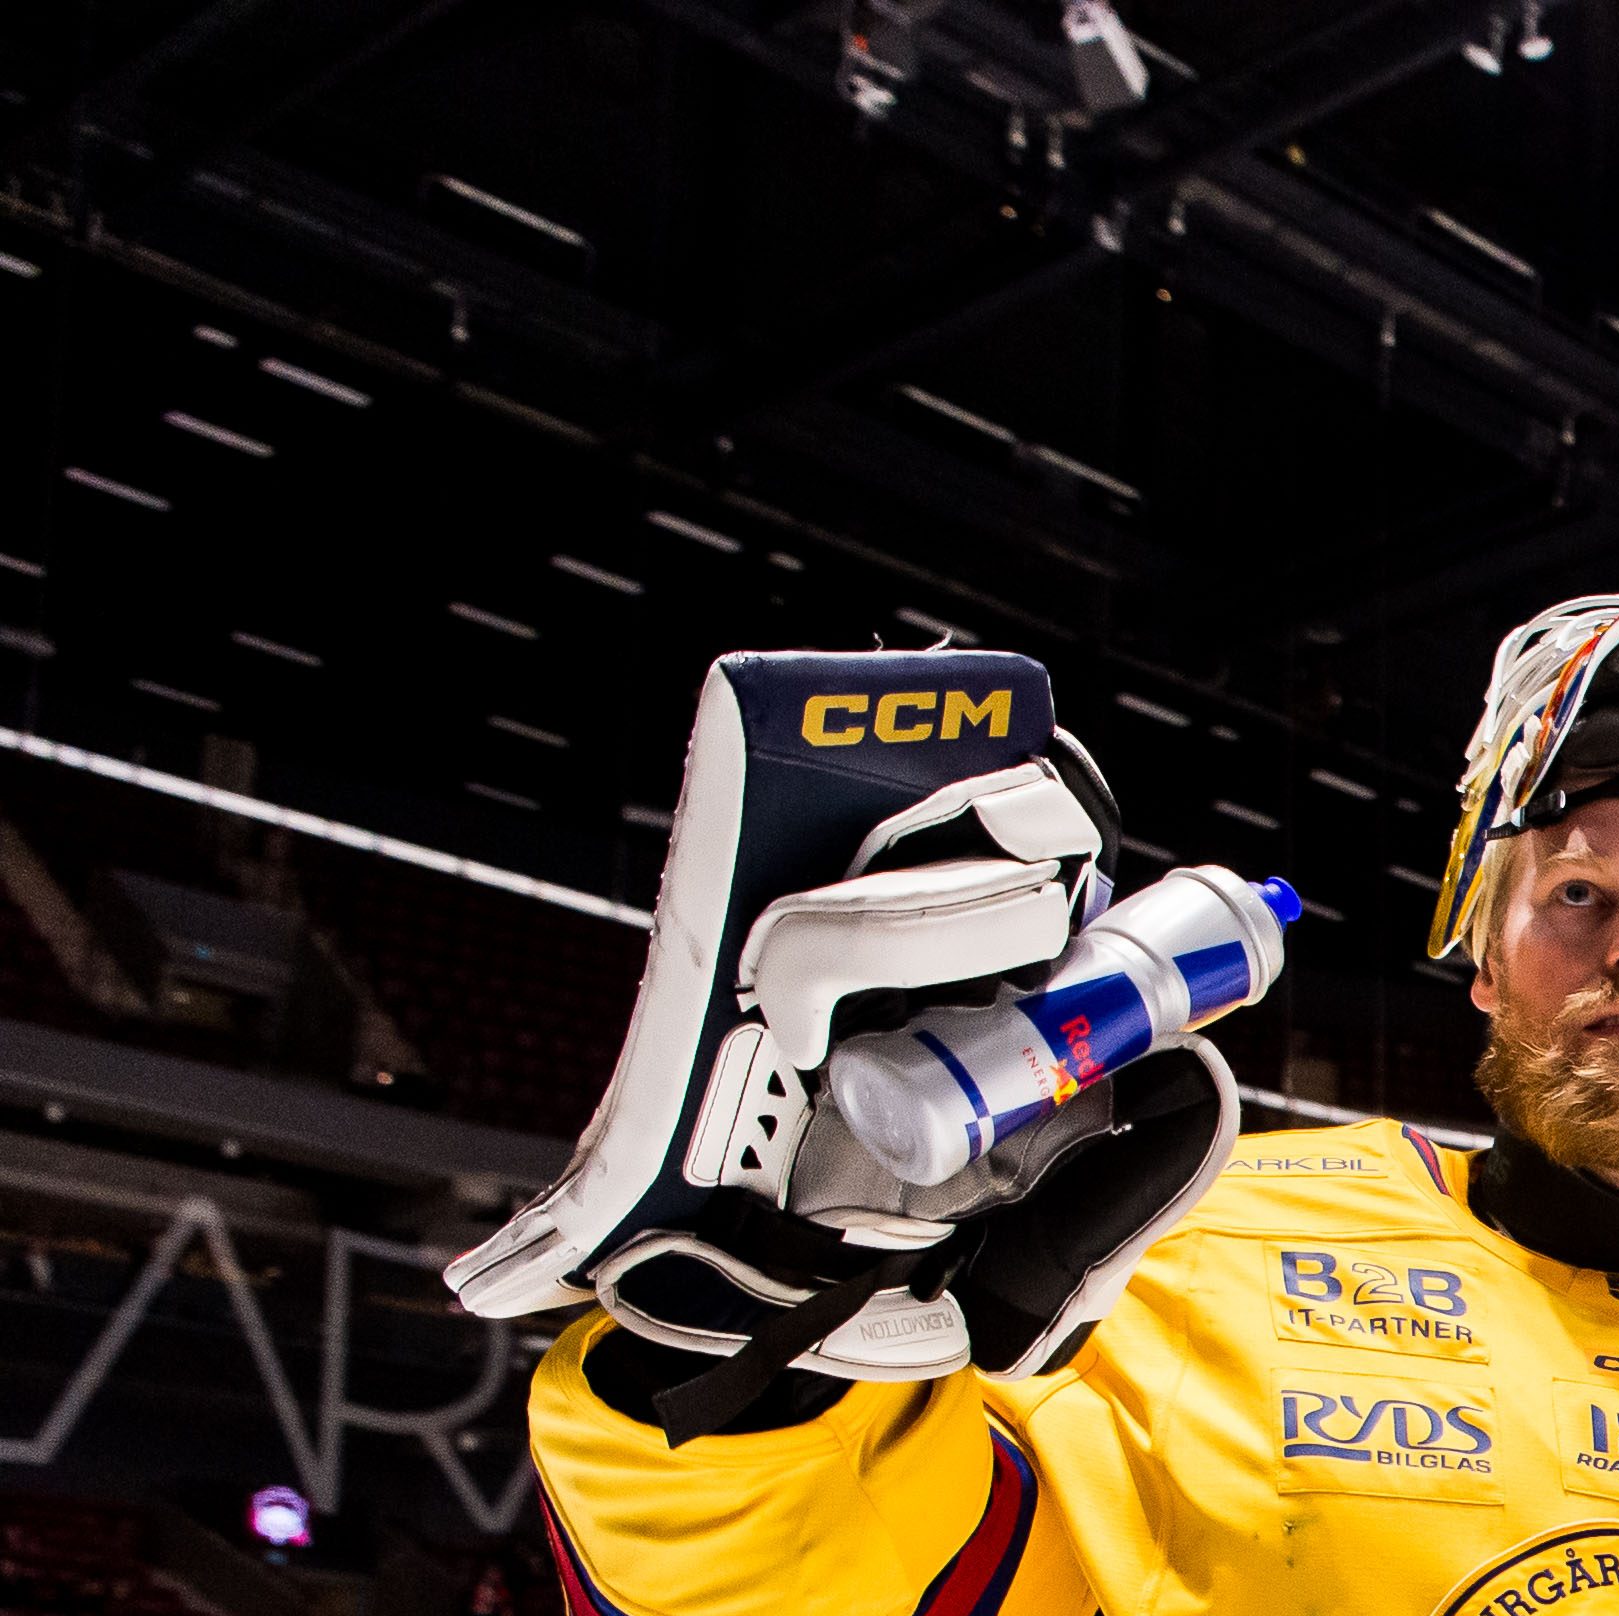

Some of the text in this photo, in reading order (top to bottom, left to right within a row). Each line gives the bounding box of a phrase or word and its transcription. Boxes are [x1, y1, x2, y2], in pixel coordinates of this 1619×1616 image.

[800, 687, 1014, 749] CCM
[1022, 1046, 1051, 1098] ENERG
[1060, 1014, 1105, 1080] Red
[1225, 1157, 1380, 1172] ARK BIL
[1280, 1250, 1469, 1317] B2B
[1288, 1308, 1473, 1344] IT-PARTNER
[1280, 1388, 1493, 1456] RYDS
[1377, 1450, 1493, 1474] BILGLAS
